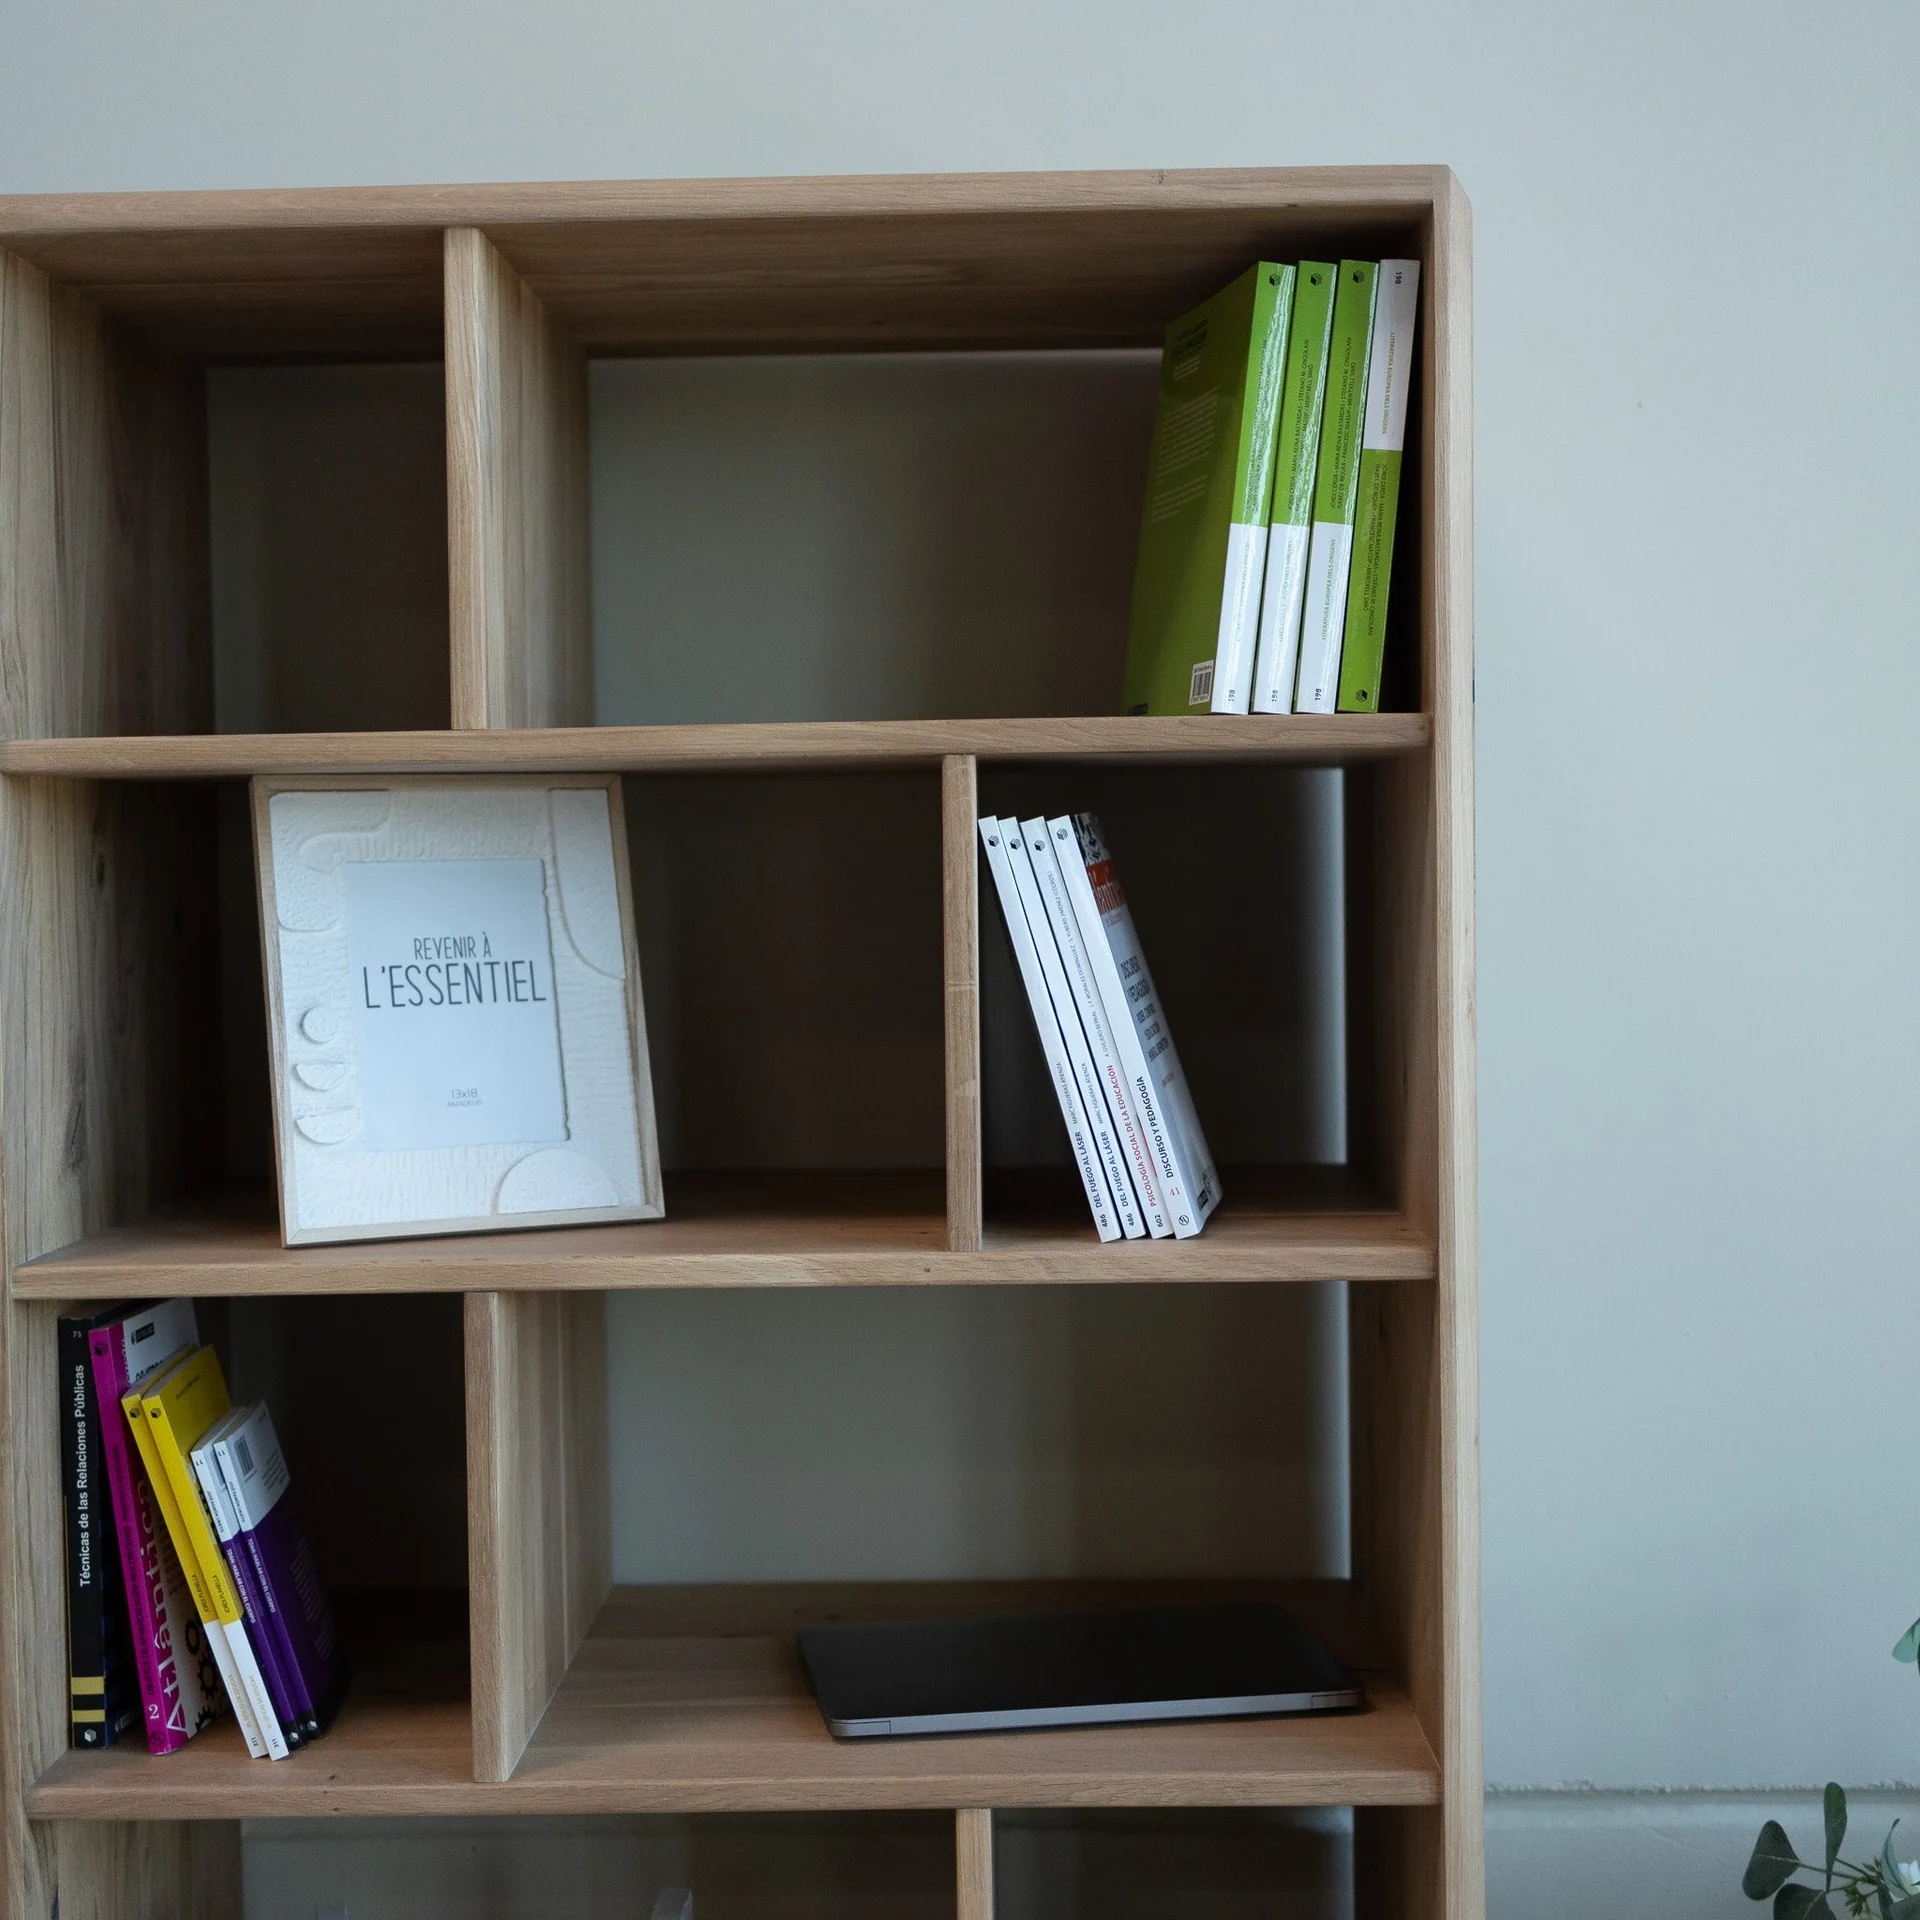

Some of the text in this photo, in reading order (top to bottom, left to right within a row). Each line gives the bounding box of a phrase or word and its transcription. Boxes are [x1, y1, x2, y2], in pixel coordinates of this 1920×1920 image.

[1394, 270, 1402, 284] 198
[1387, 332, 1395, 366] LITERATURA
[1384, 366, 1393, 393] EUROPEA
[1325, 564, 1333, 578] DELS
[1323, 579, 1331, 606] EUROPEA
[1270, 688, 1278, 703] 198
[1313, 687, 1322, 701] 198
[414, 931, 492, 960] REVENIR À
[363, 960, 547, 1009] L'ESSENTIEL
[451, 1088, 478, 1100] 13x18
[1133, 1075, 1158, 1127] PEDAGOGÍA
[1120, 1109, 1130, 1121] LA
[1124, 1120, 1133, 1132] DE
[1151, 1126, 1159, 1134] Y
[1127, 1132, 1143, 1160] SOCIAL
[1153, 1133, 1173, 1178] DISCURSO
[1073, 1130, 1109, 1228] 486 DEL FUEGO AL LÁSER
[1098, 1130, 1135, 1227] 486 DEL FUEGO AL LÁSER
[1136, 1159, 1156, 1207] PSICOLOGÍA
[1154, 1212, 1163, 1228] 602
[72, 1364, 90, 1587] Técnicas de las Relaciones Públicas
[230, 1563, 243, 1585] HABLAR
[258, 1573, 268, 1586] CON
[237, 1583, 247, 1596] CON
[262, 1584, 270, 1592] EL
[241, 1595, 249, 1603] EL
[244, 1601, 256, 1624] CUERPO
[149, 1704, 160, 1720] 2
